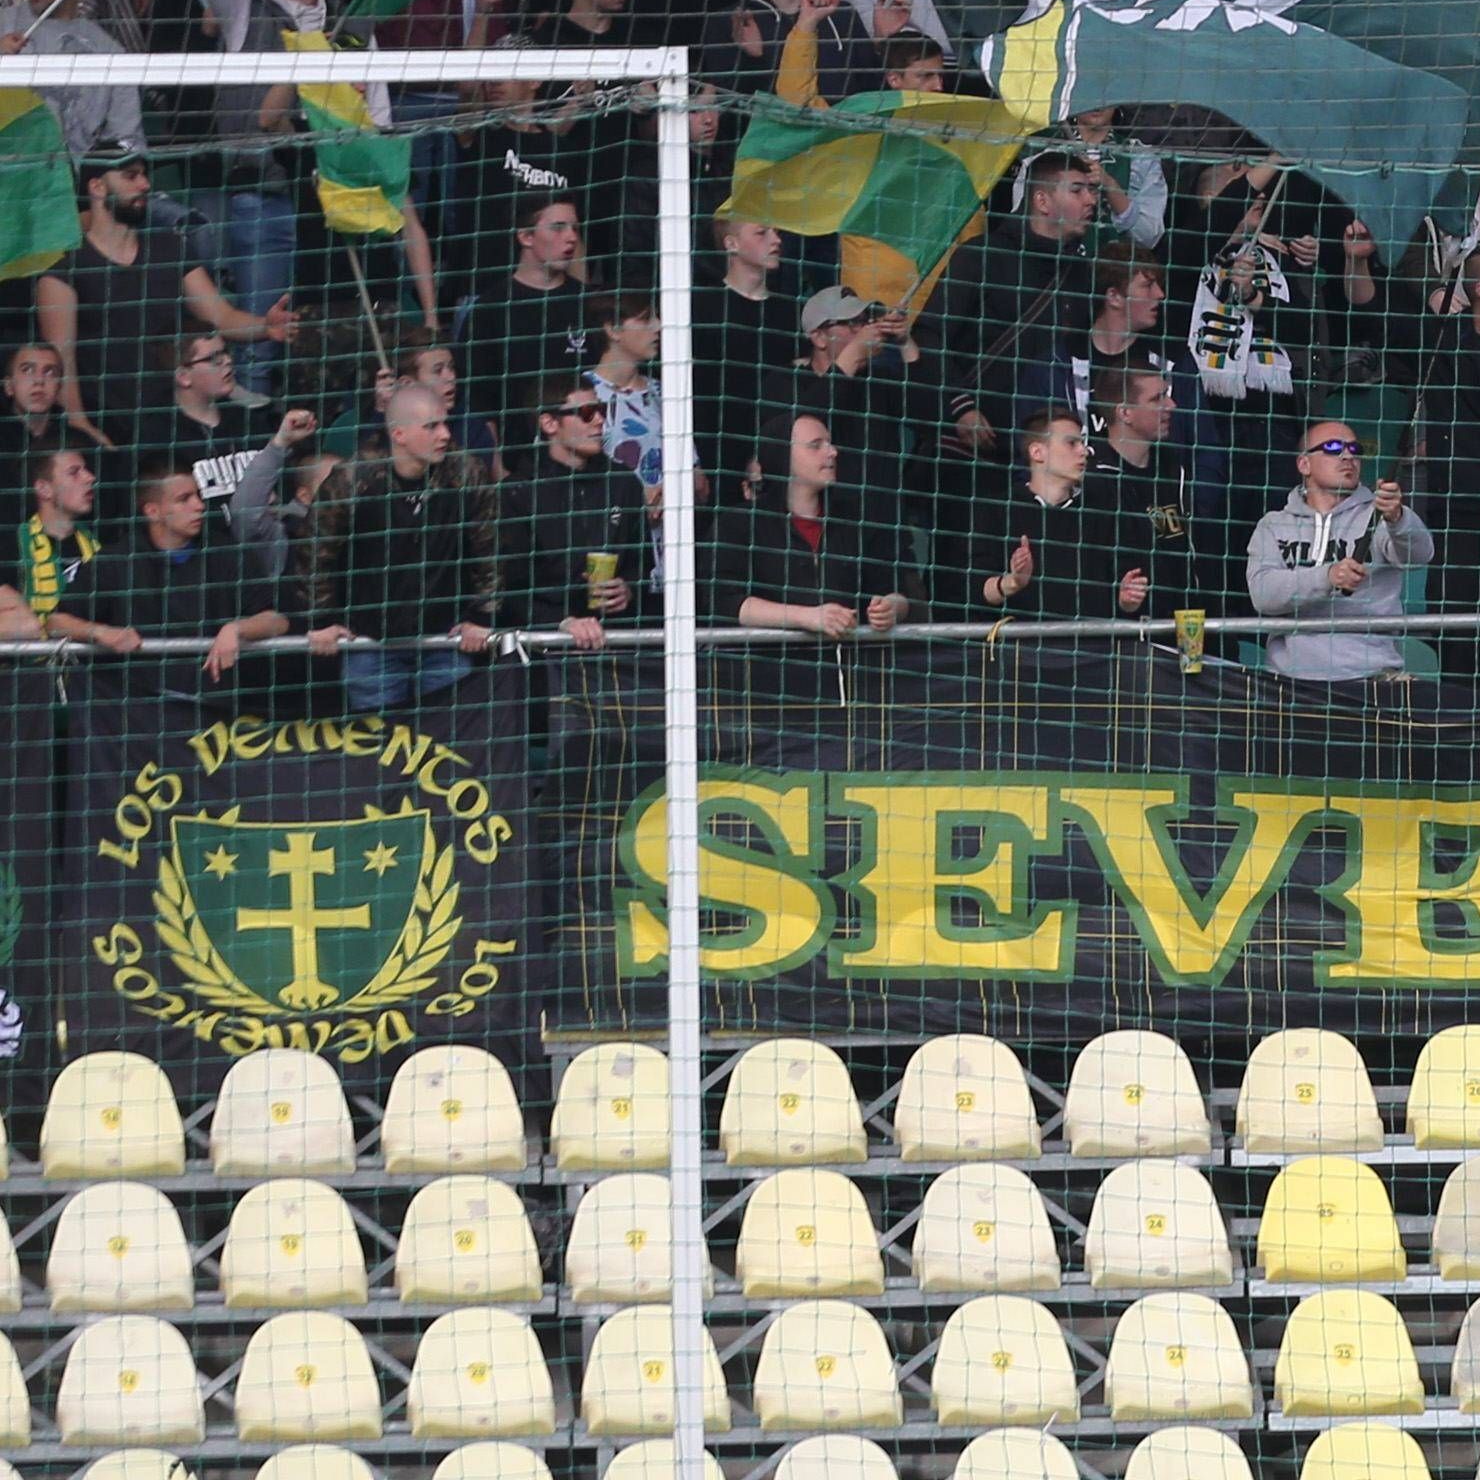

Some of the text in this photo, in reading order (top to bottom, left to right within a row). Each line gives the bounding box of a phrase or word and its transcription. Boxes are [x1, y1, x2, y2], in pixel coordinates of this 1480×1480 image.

[98, 715, 512, 869] LOS DEMENTOS
[93, 922, 415, 1064] DEMENTOS
[425, 938, 517, 1018] LOS
